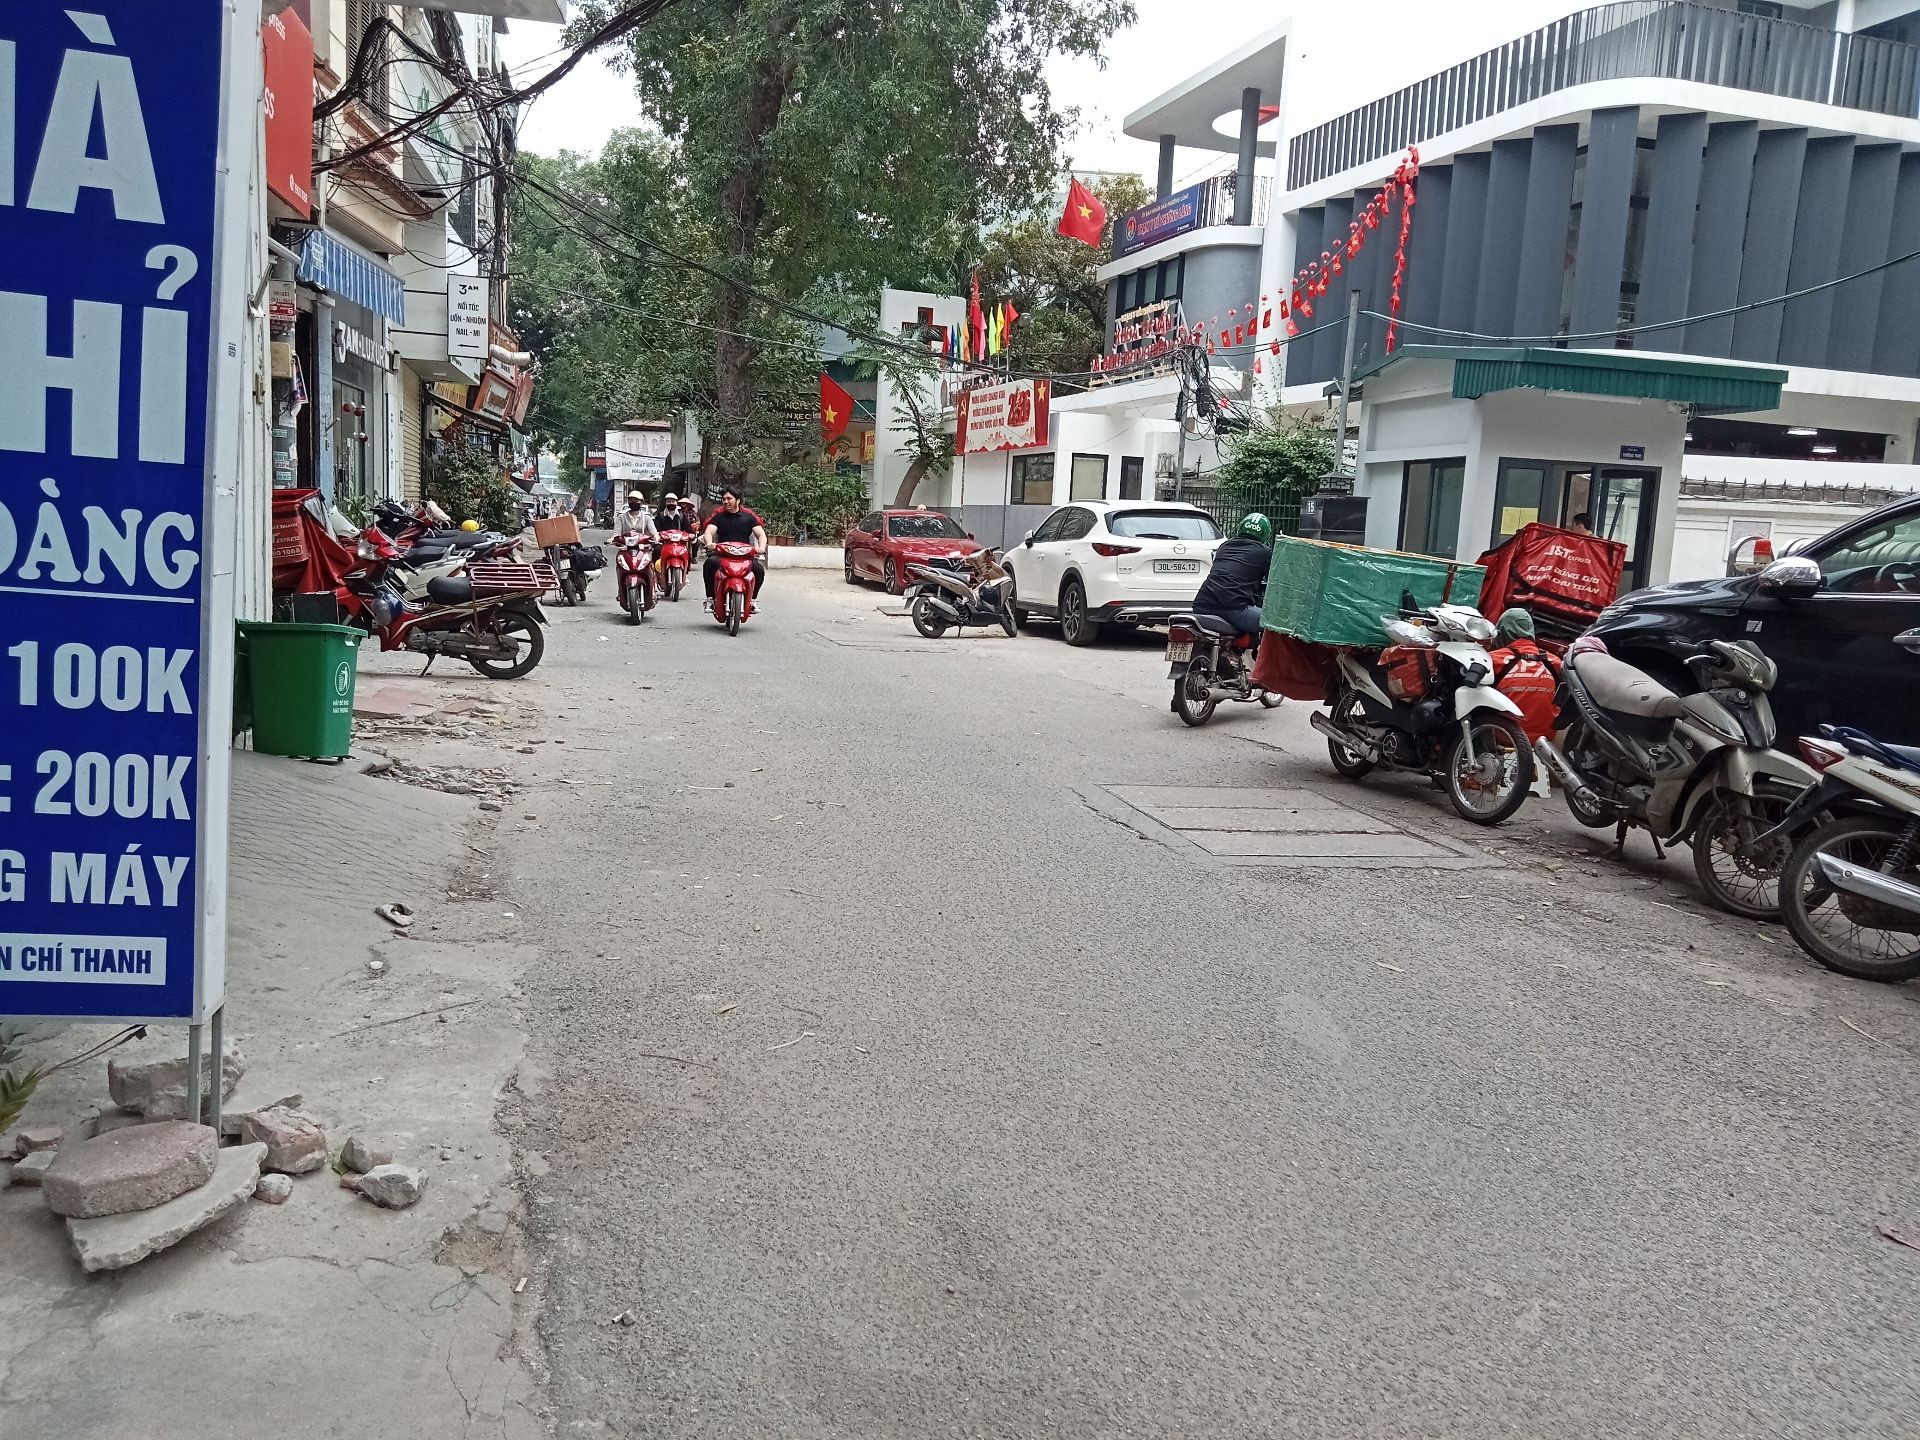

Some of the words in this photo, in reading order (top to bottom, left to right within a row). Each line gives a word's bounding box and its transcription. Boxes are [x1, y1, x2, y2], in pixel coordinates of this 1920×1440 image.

[1245, 522, 1261, 532] Grab
[1158, 563, 1196, 572] 30L-584.12
[1543, 544, 1576, 559] J&T
[9, 640, 195, 715] 100K
[35, 750, 193, 820] 200K
[51, 844, 191, 907] MÁY
[21, 942, 63, 973] CHÍ
[71, 947, 151, 974] THANH
